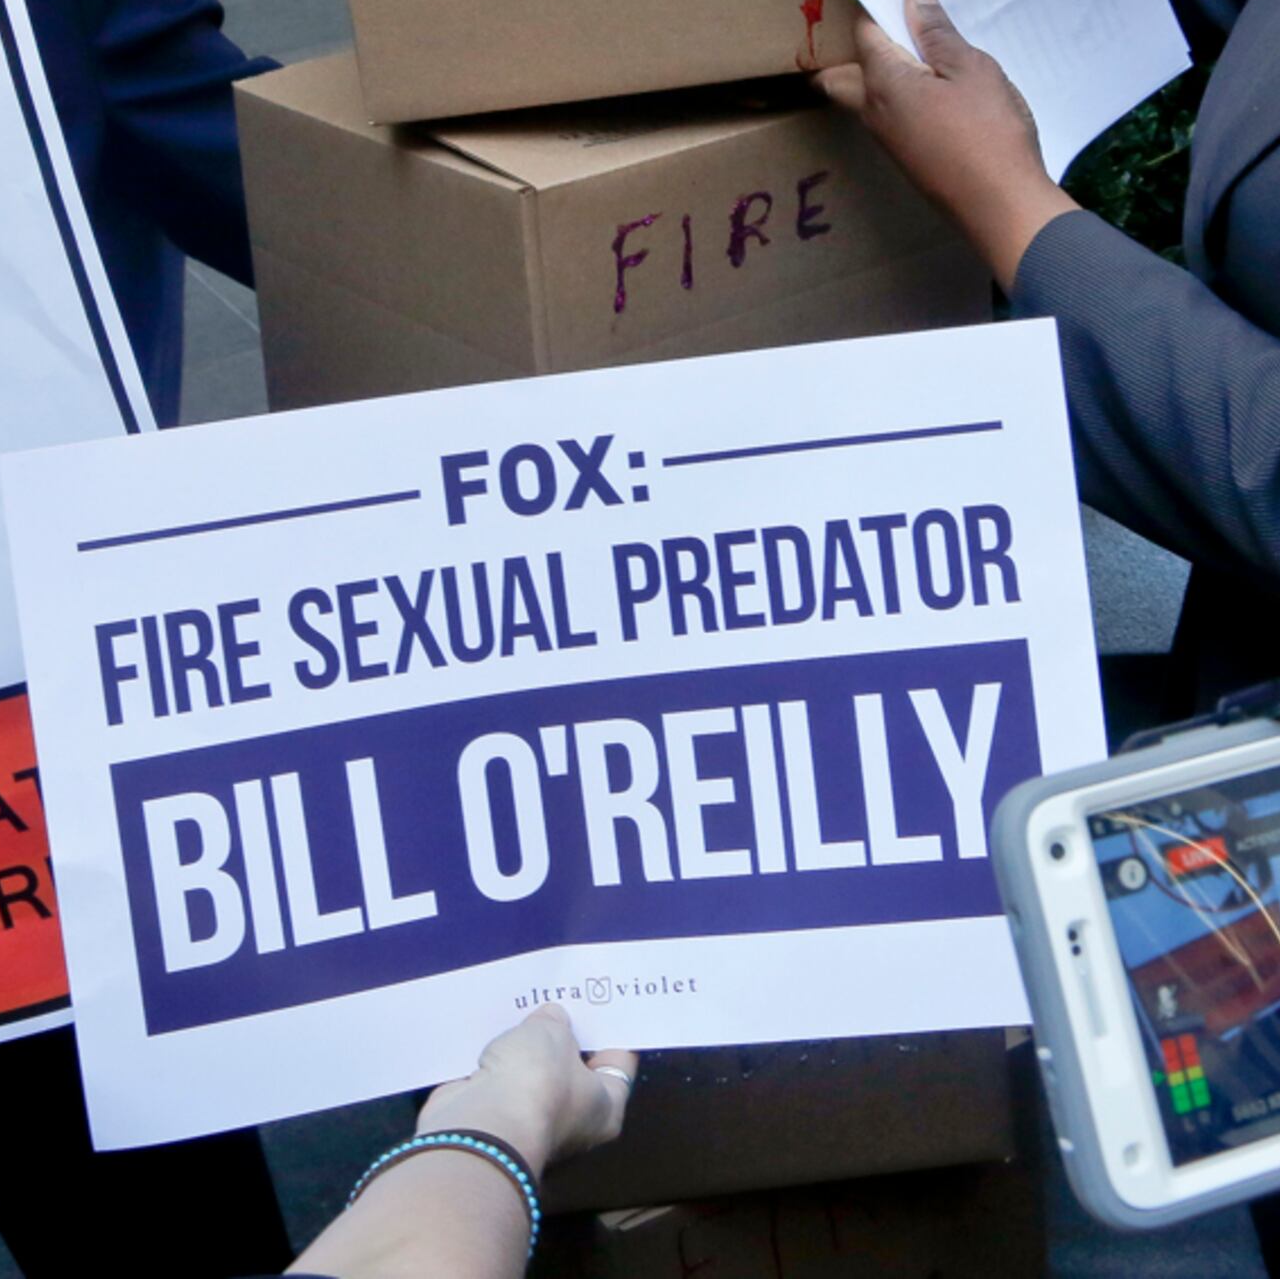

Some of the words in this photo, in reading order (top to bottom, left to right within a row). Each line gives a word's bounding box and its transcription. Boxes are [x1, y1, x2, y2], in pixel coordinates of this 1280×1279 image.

[612, 169, 834, 314] FIRE
[438, 433, 652, 526] FOX:
[93, 597, 273, 726] FIRE
[287, 552, 596, 691] SEXUAL
[612, 503, 1022, 643] PREDATOR
[140, 756, 439, 974] BILL
[456, 681, 1003, 903] O'REILLY
[514, 985, 583, 1010] ultra
[616, 975, 698, 997] violet
